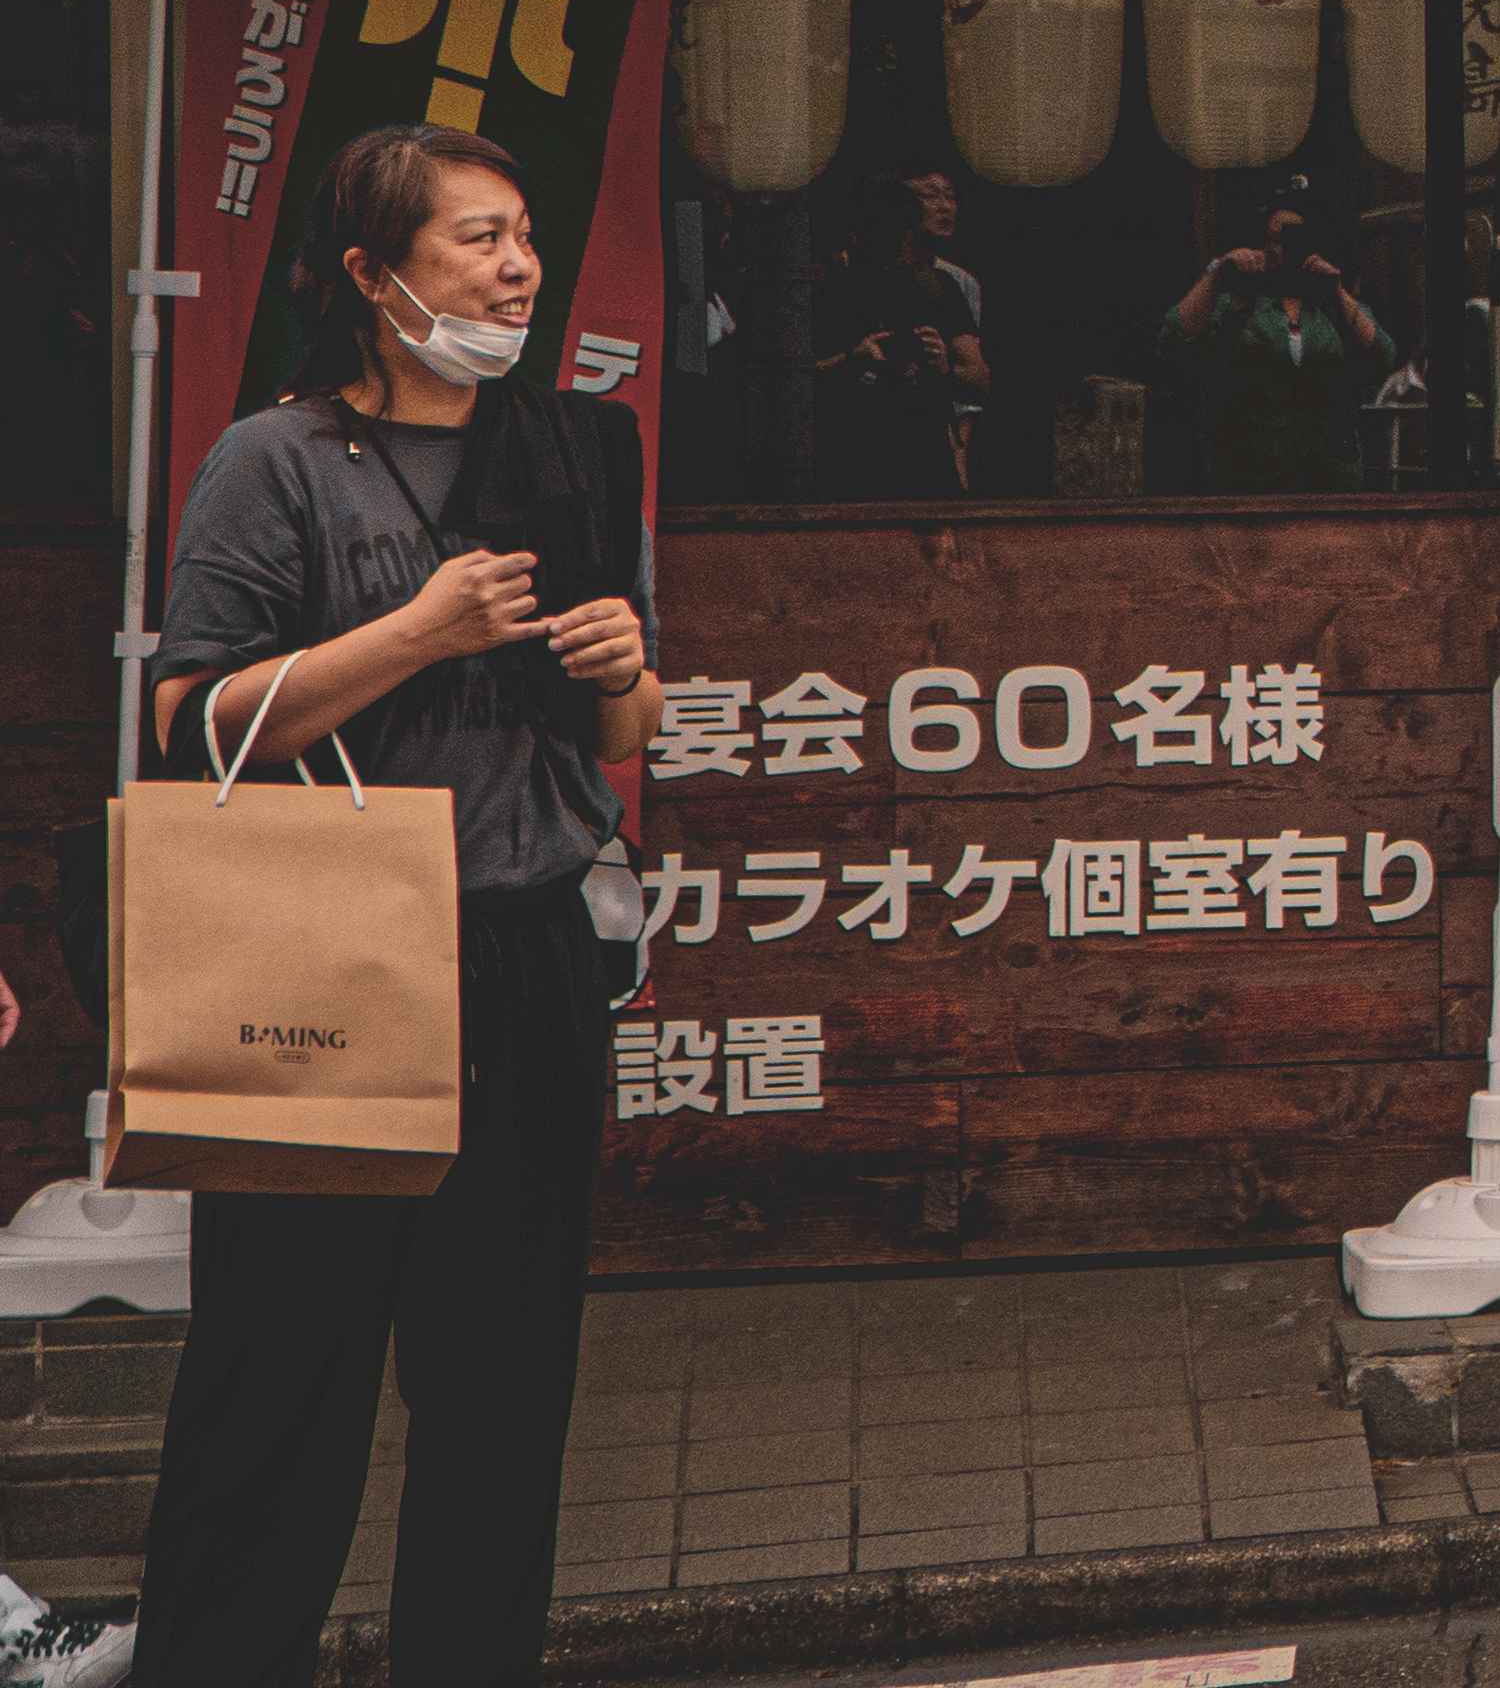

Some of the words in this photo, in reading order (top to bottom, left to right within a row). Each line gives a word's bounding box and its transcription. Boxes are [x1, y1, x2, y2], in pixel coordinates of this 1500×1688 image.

[647, 664, 1326, 780] 宴会60名様
[641, 830, 1436, 946] カラオケ個室有り
[613, 1015, 826, 1120] 設置
